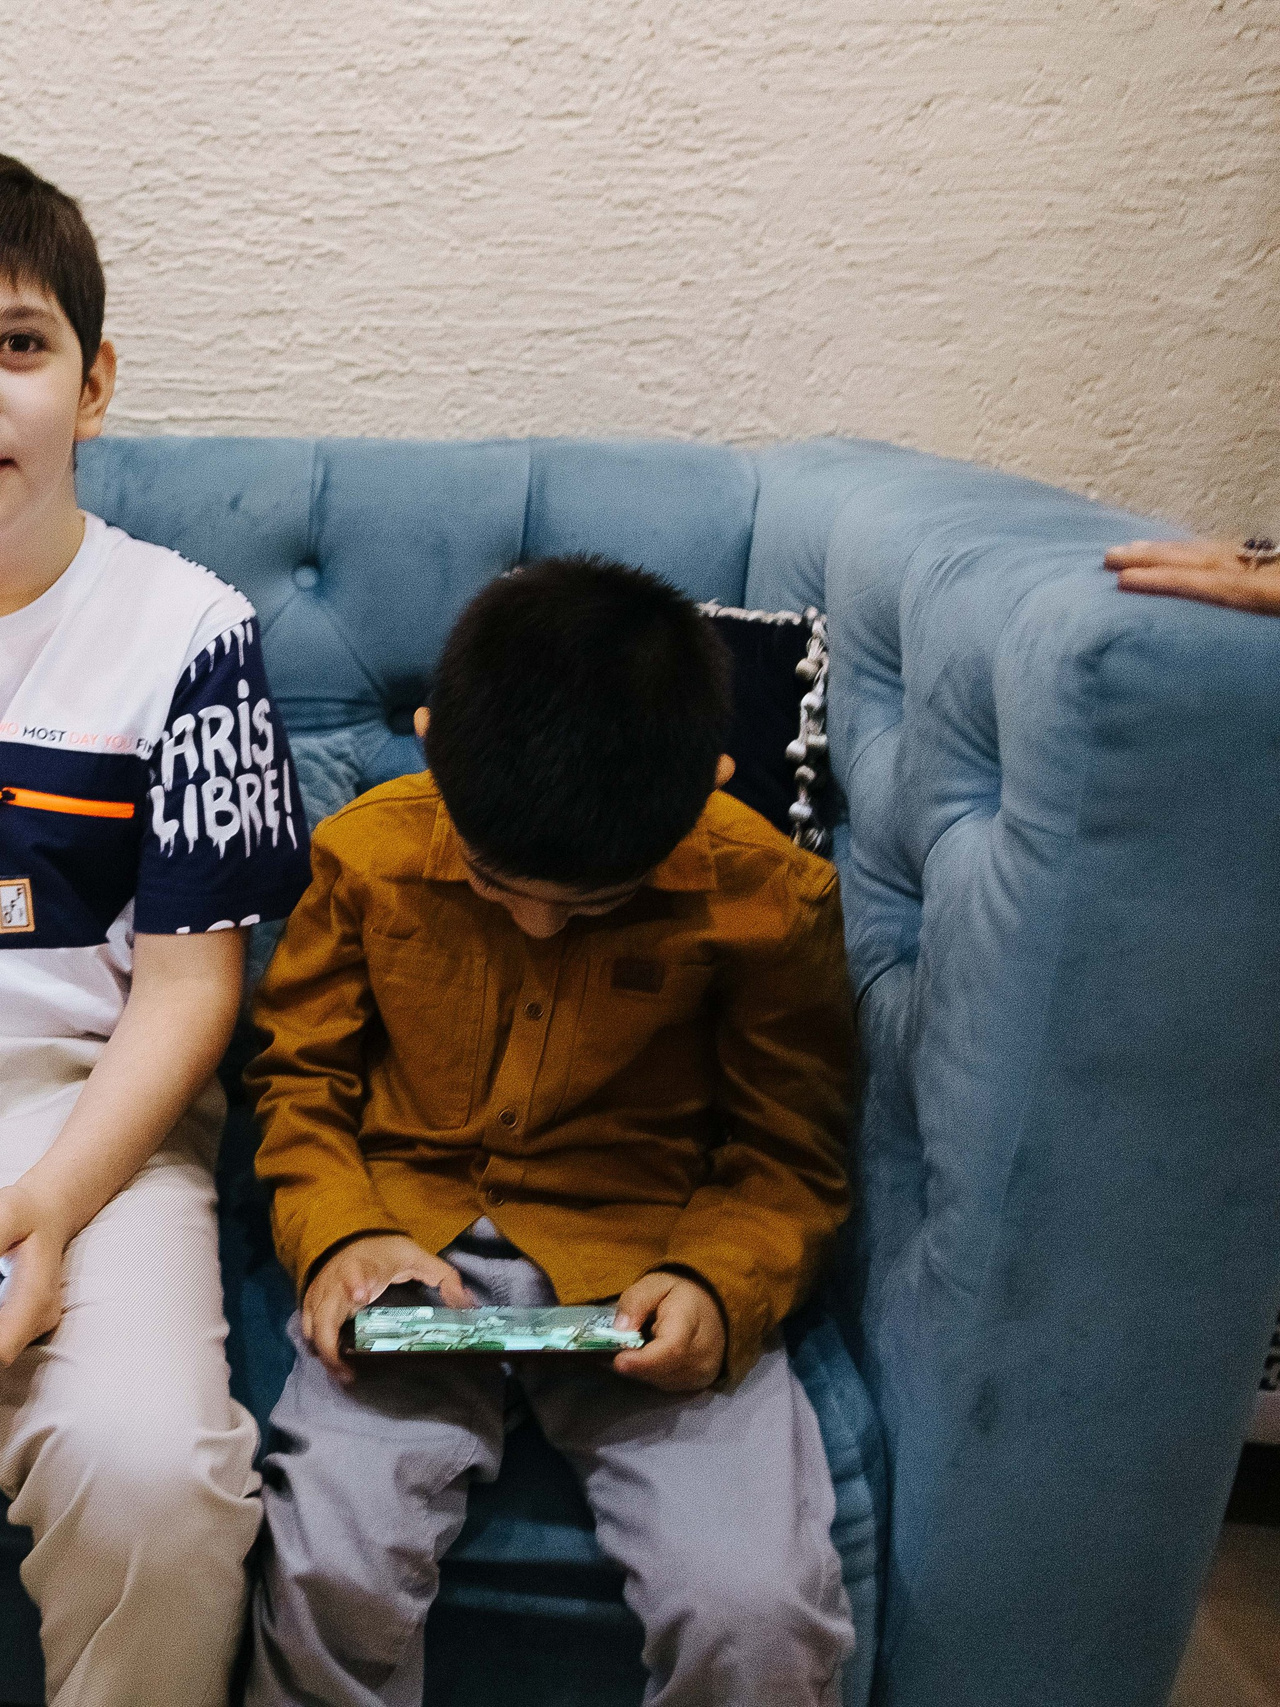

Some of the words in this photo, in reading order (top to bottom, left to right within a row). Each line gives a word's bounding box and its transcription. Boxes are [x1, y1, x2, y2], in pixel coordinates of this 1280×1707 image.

[22, 724, 68, 743] MOST
[68, 731, 99, 746] DAY
[104, 733, 134, 750] YOU
